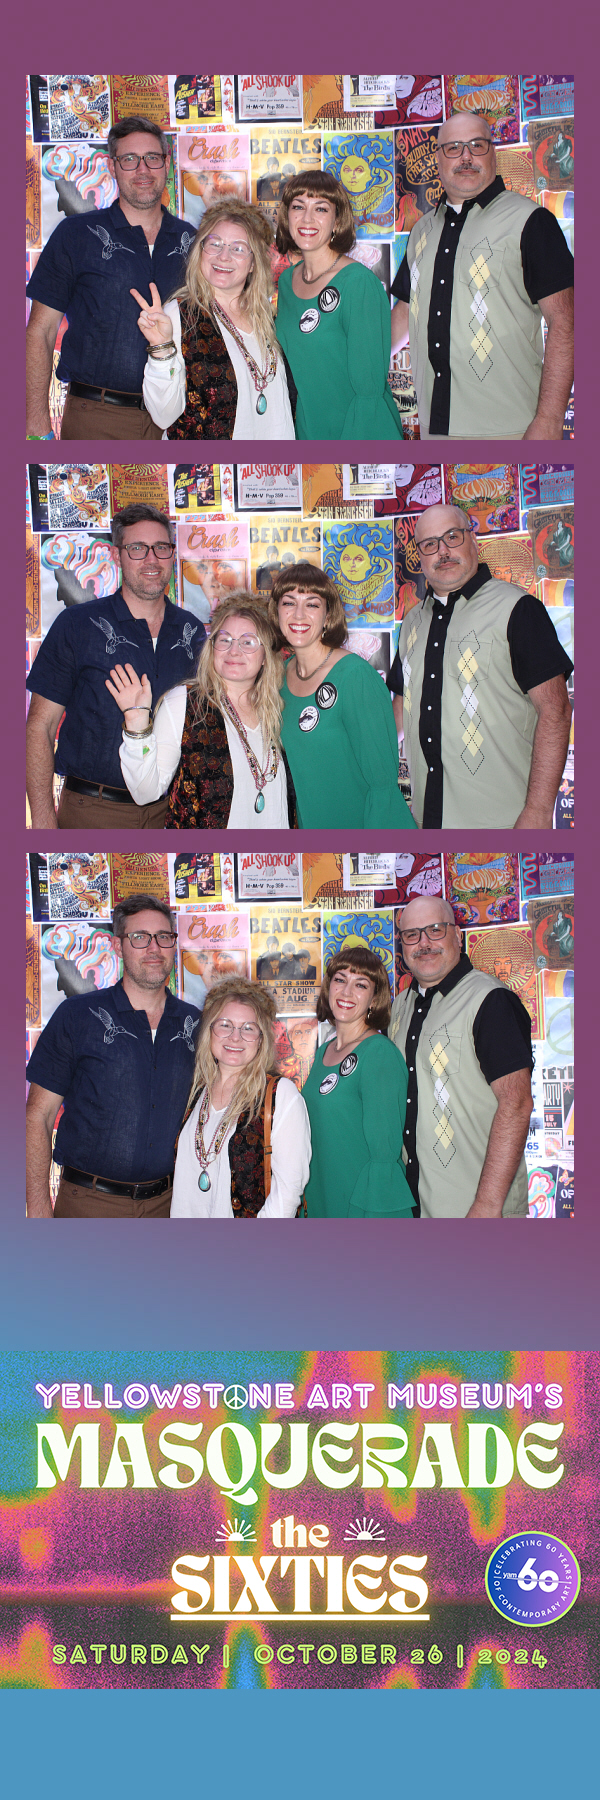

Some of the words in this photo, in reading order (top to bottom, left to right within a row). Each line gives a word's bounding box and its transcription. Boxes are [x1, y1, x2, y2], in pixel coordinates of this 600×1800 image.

[242, 75, 255, 91] ALL
[256, 75, 283, 90] SHOOK
[285, 75, 296, 87] UP
[188, 136, 240, 161] Crush
[250, 137, 321, 154] BEATLES
[241, 464, 254, 480] ALL
[255, 464, 282, 479] SHOOK
[284, 464, 295, 476] UP
[187, 525, 239, 550] Crush
[249, 526, 320, 543] BEATLES
[242, 854, 255, 870] ALL
[256, 854, 283, 869] SHOOK
[285, 854, 296, 866] UP
[188, 915, 240, 940] Crush
[250, 916, 321, 933] BEATLES
